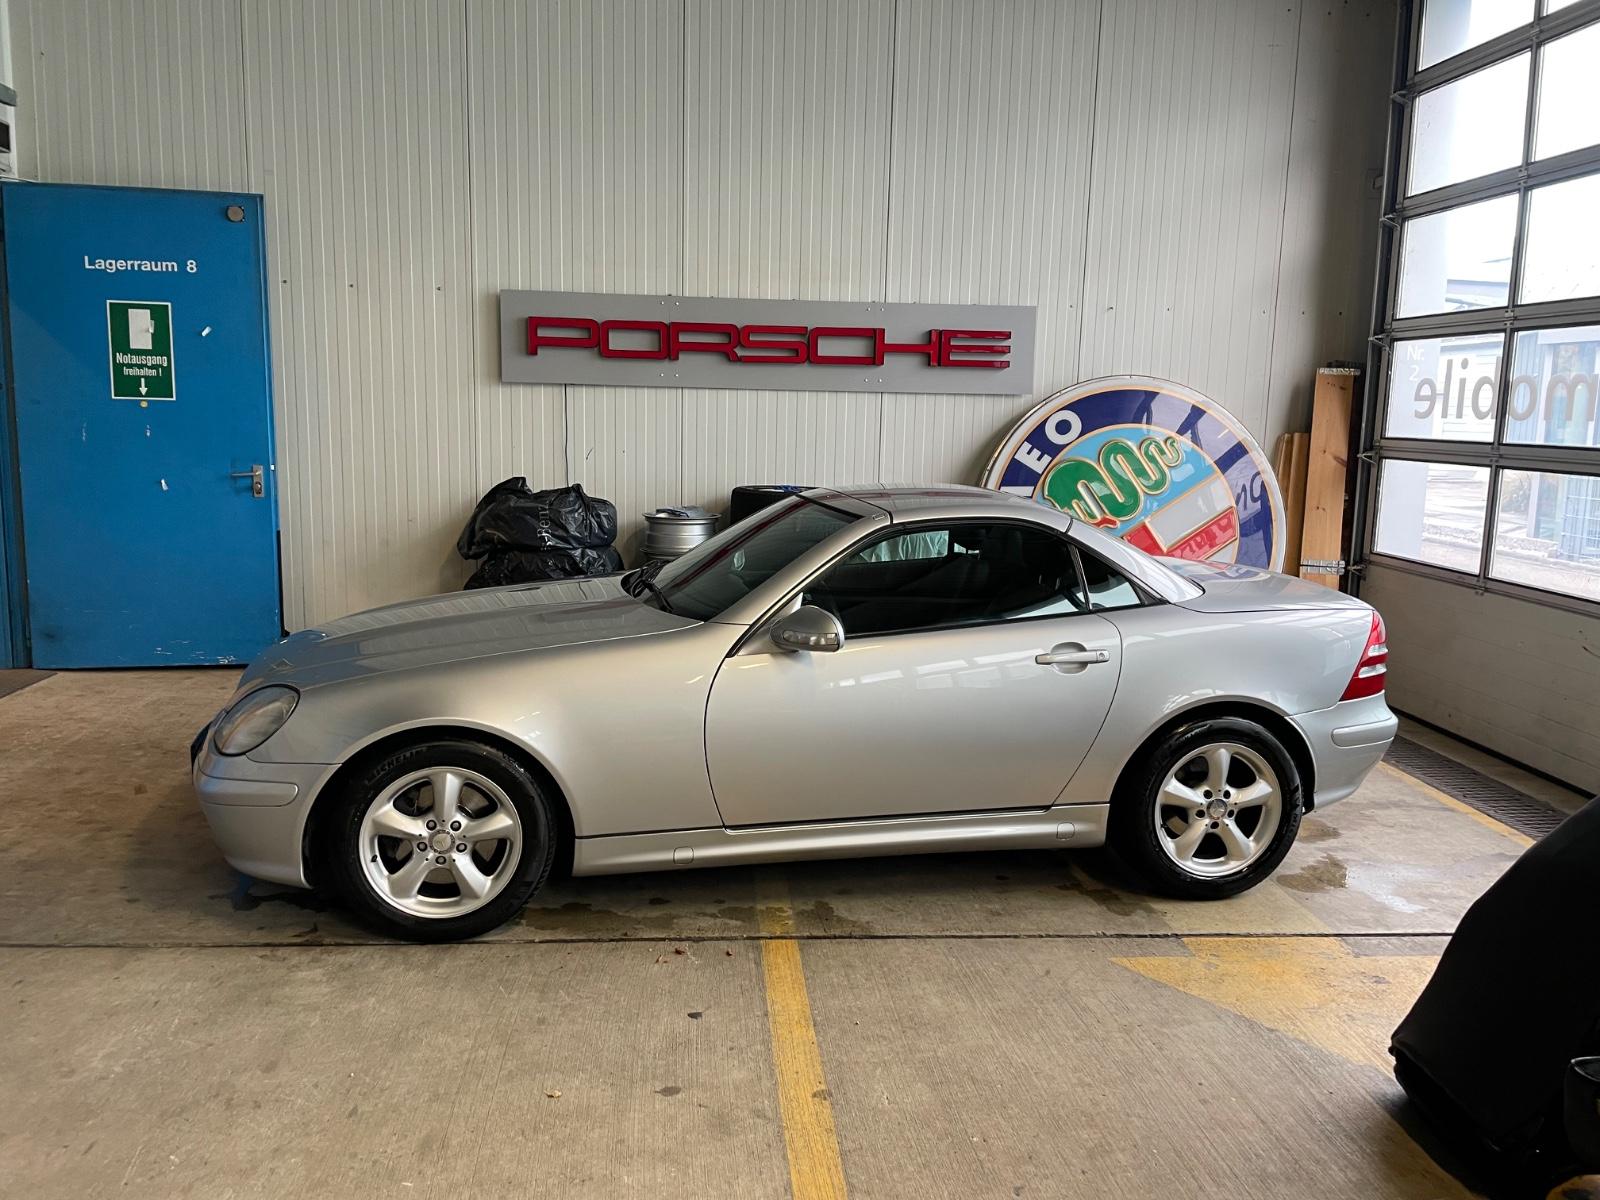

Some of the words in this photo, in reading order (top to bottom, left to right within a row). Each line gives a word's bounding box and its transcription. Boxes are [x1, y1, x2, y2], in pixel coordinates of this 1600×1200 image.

[84, 255, 178, 273] Lagerraum
[186, 259, 197, 273] 8
[527, 316, 1012, 369] PORSCHE
[116, 352, 168, 367] Notausgang
[123, 366, 157, 377] freihalten
